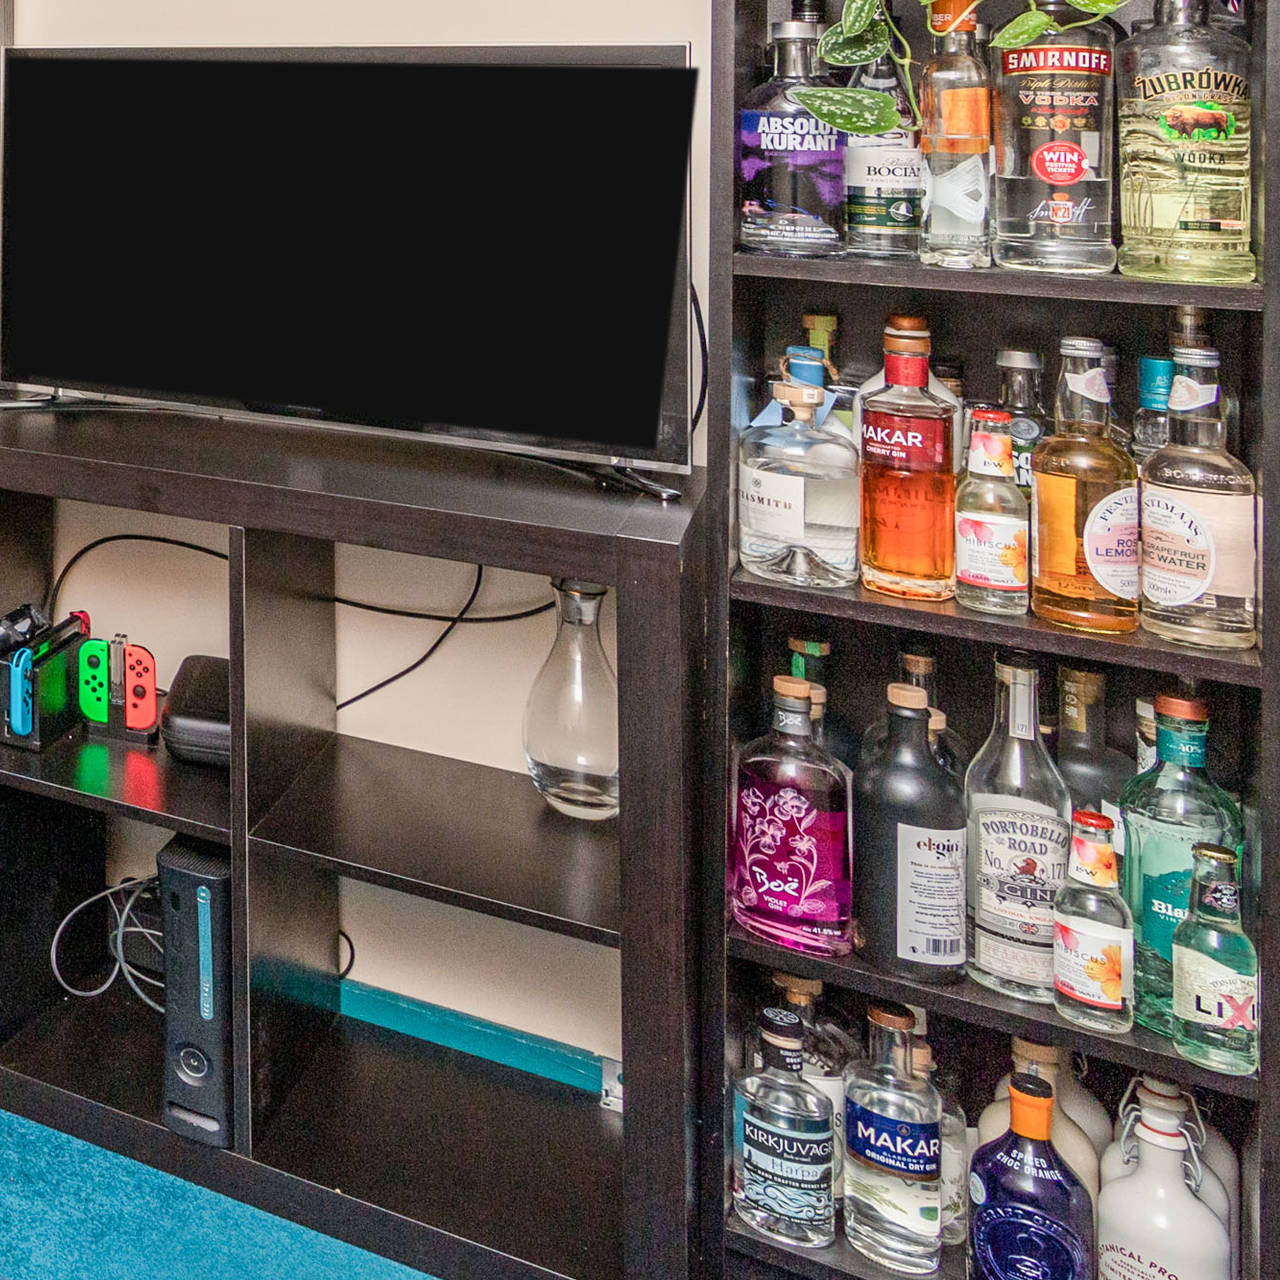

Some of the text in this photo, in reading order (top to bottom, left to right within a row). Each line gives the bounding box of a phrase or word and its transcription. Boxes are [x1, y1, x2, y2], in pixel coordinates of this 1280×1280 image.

[1008, 51, 1108, 71] SMIRNOFF
[1135, 67, 1249, 101] ŻUBRÓWKA
[1019, 94, 1099, 106] VODKA
[760, 133, 838, 152] KURANT
[1042, 151, 1079, 163] WIN
[891, 449, 907, 458] GIN
[965, 538, 1018, 552] HIBISCUS
[1116, 539, 1138, 549] ROS
[1157, 554, 1208, 571] WATER
[981, 820, 1069, 849] PORTOBELLO
[1007, 836, 1049, 857] ROAD
[751, 866, 800, 898] Boë
[1003, 883, 1053, 902] GIN
[856, 1120, 940, 1158] MAKAR
[771, 1158, 819, 1181] Harpa
[865, 1148, 907, 1171] ORIGINAL
[908, 1158, 926, 1172] DRY
[996, 1151, 1063, 1181] CHOC ORANGE
